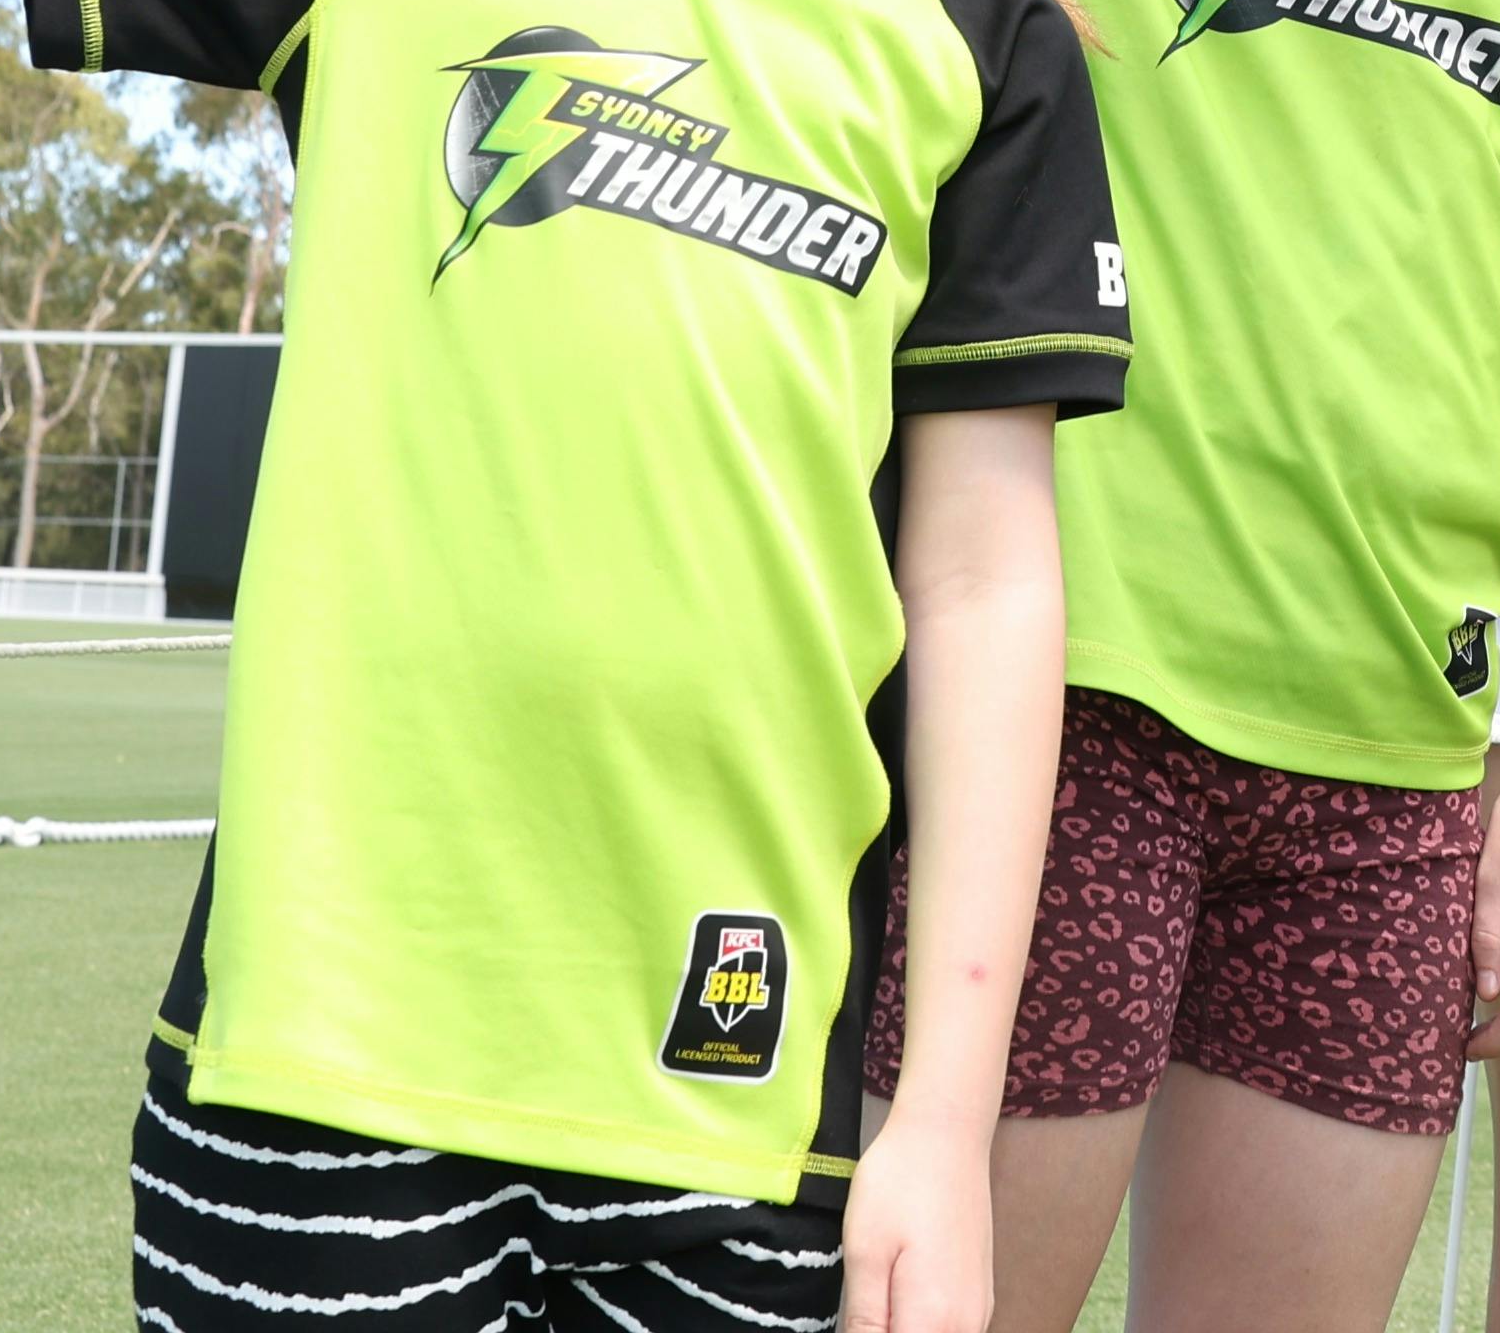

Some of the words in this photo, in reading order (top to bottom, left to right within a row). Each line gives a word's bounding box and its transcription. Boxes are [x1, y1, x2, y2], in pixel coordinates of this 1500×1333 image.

[571, 88, 717, 153] SYDNEY
[566, 131, 883, 288] THUNDER
[726, 933, 757, 948] KFC
[704, 971, 766, 1005] BBL
[675, 1048, 720, 1062] LICENSED
[721, 1052, 761, 1065] PRODUCT
[703, 1041, 739, 1052] OFFICIAL
